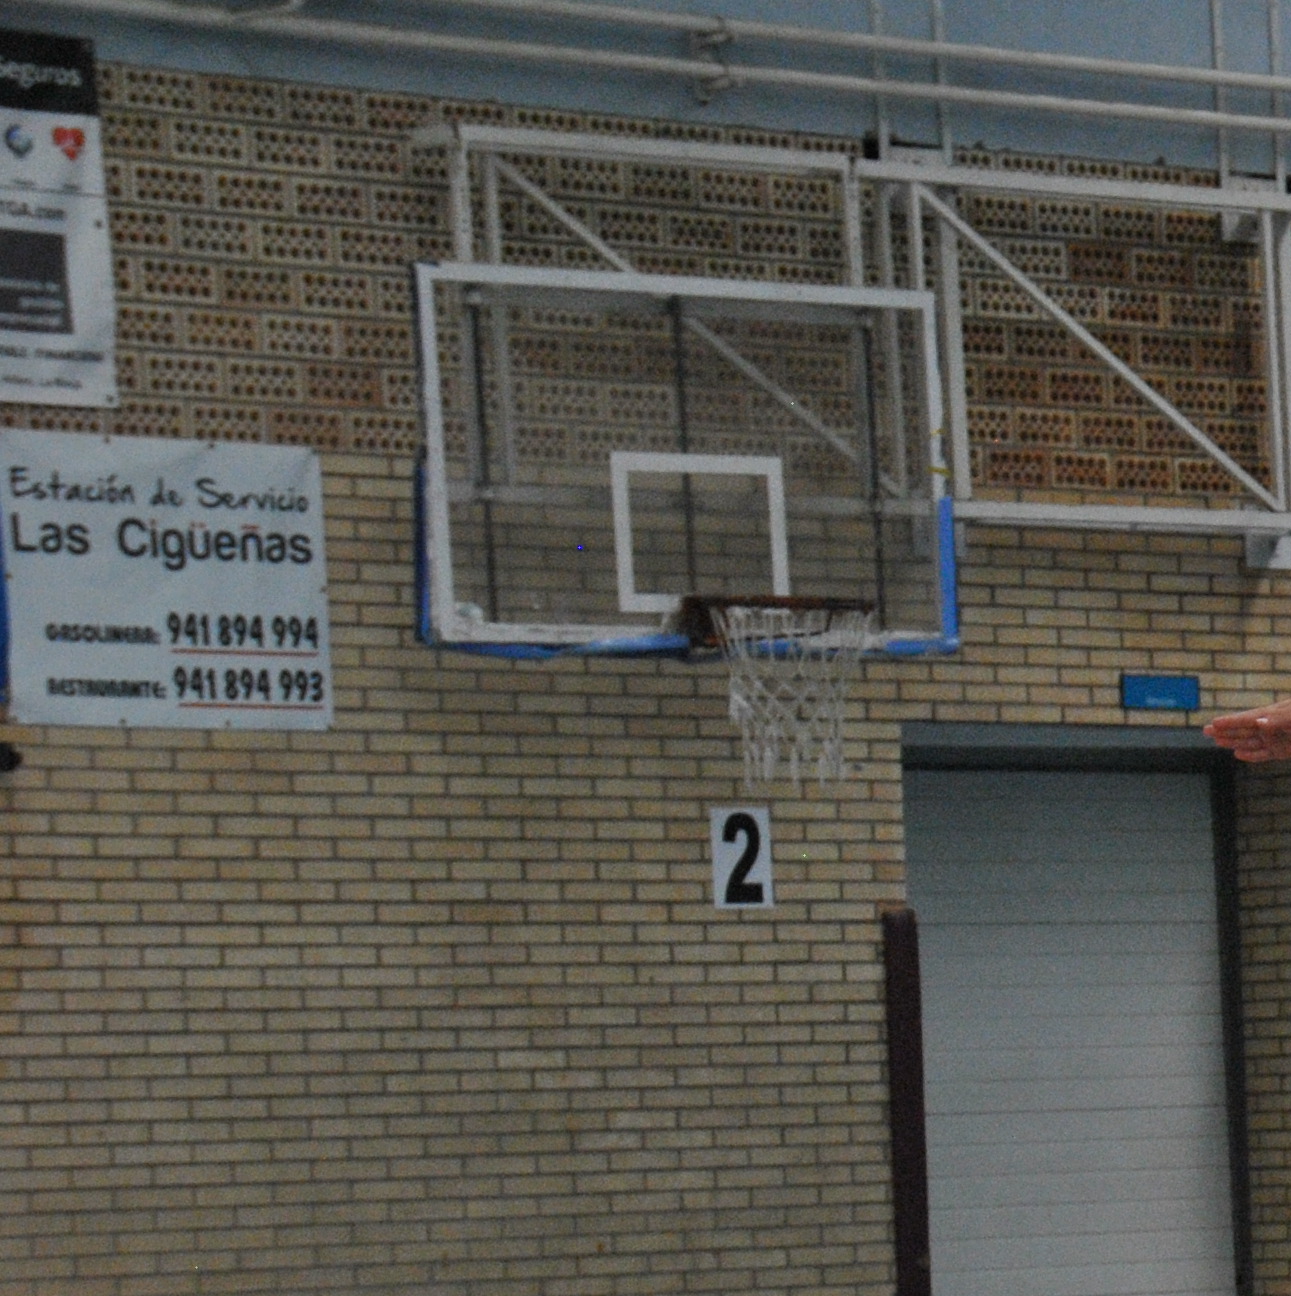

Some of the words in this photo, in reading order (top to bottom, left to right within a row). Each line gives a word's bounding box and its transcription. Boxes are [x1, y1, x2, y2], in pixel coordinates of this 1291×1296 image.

[9, 465, 135, 504] Estación
[150, 477, 183, 506] de
[195, 477, 310, 513] Servicio
[10, 512, 90, 555] Las
[117, 517, 313, 570] Cigüeñas
[167, 611, 211, 646] 941
[218, 614, 264, 648] 894
[272, 615, 319, 650] 994
[174, 665, 217, 699] 941
[225, 668, 271, 701] 894
[279, 668, 324, 702] 993
[722, 811, 764, 904] 2
